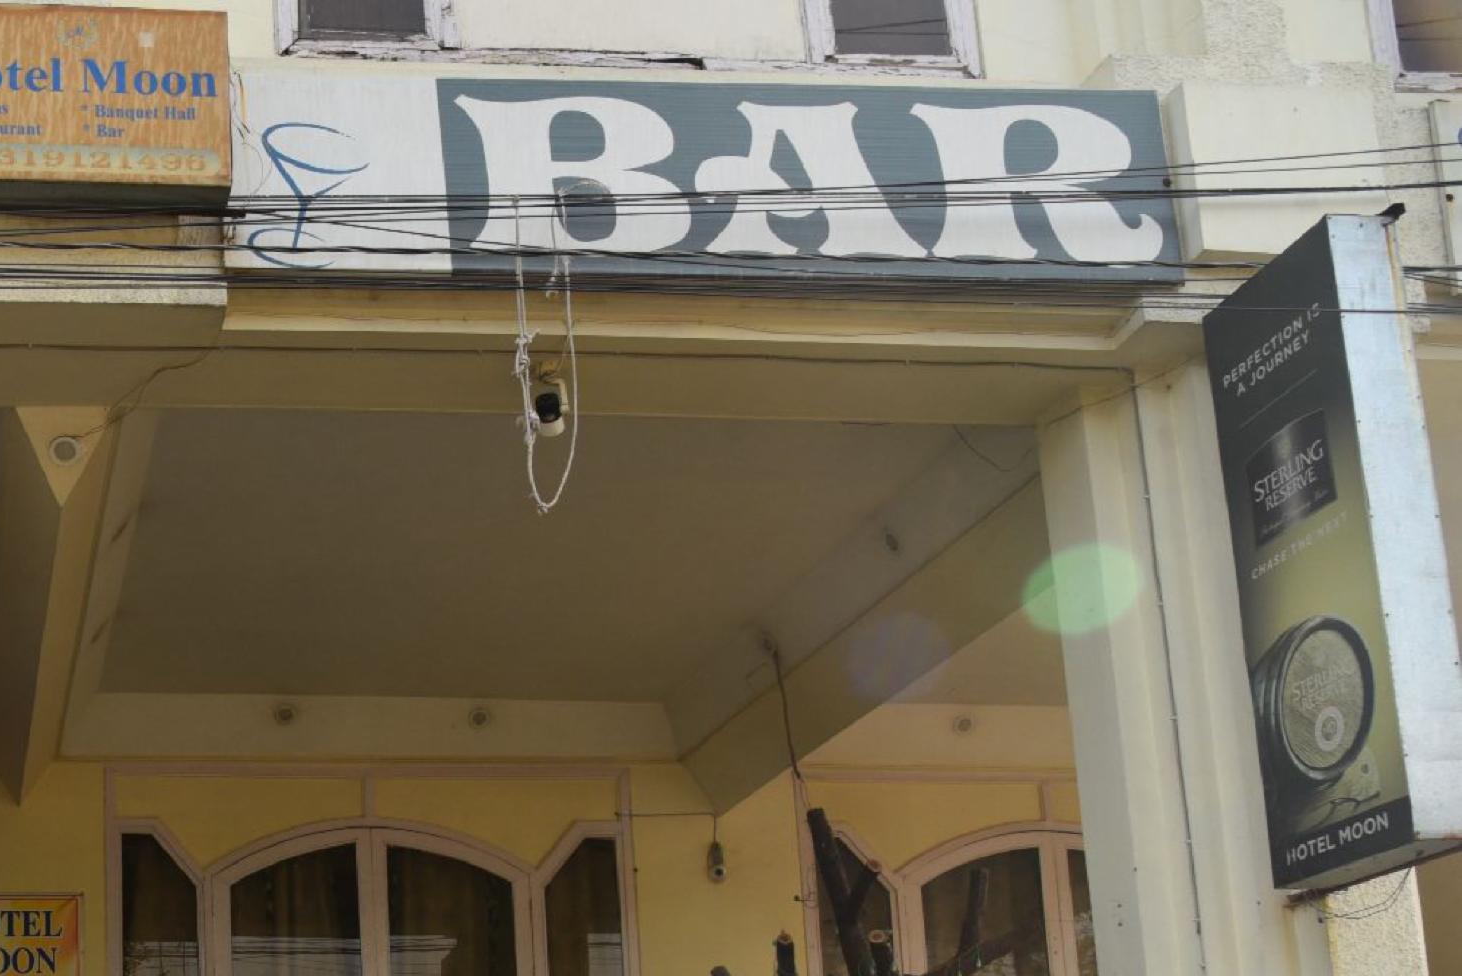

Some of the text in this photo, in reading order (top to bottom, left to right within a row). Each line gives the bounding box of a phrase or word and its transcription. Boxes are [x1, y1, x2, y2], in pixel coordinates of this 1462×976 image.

[81, 58, 218, 97] Moon
[94, 104, 197, 121] Banquet Hall
[96, 124, 126, 138] Bar
[454, 94, 1164, 265] BAR
[1223, 316, 1303, 388] PERFECTION
[1237, 330, 1310, 397] A JOURNEY
[1254, 439, 1324, 502] STERLING
[1265, 466, 1318, 512] RESERVE
[1286, 812, 1389, 866] HOTEL MOON
